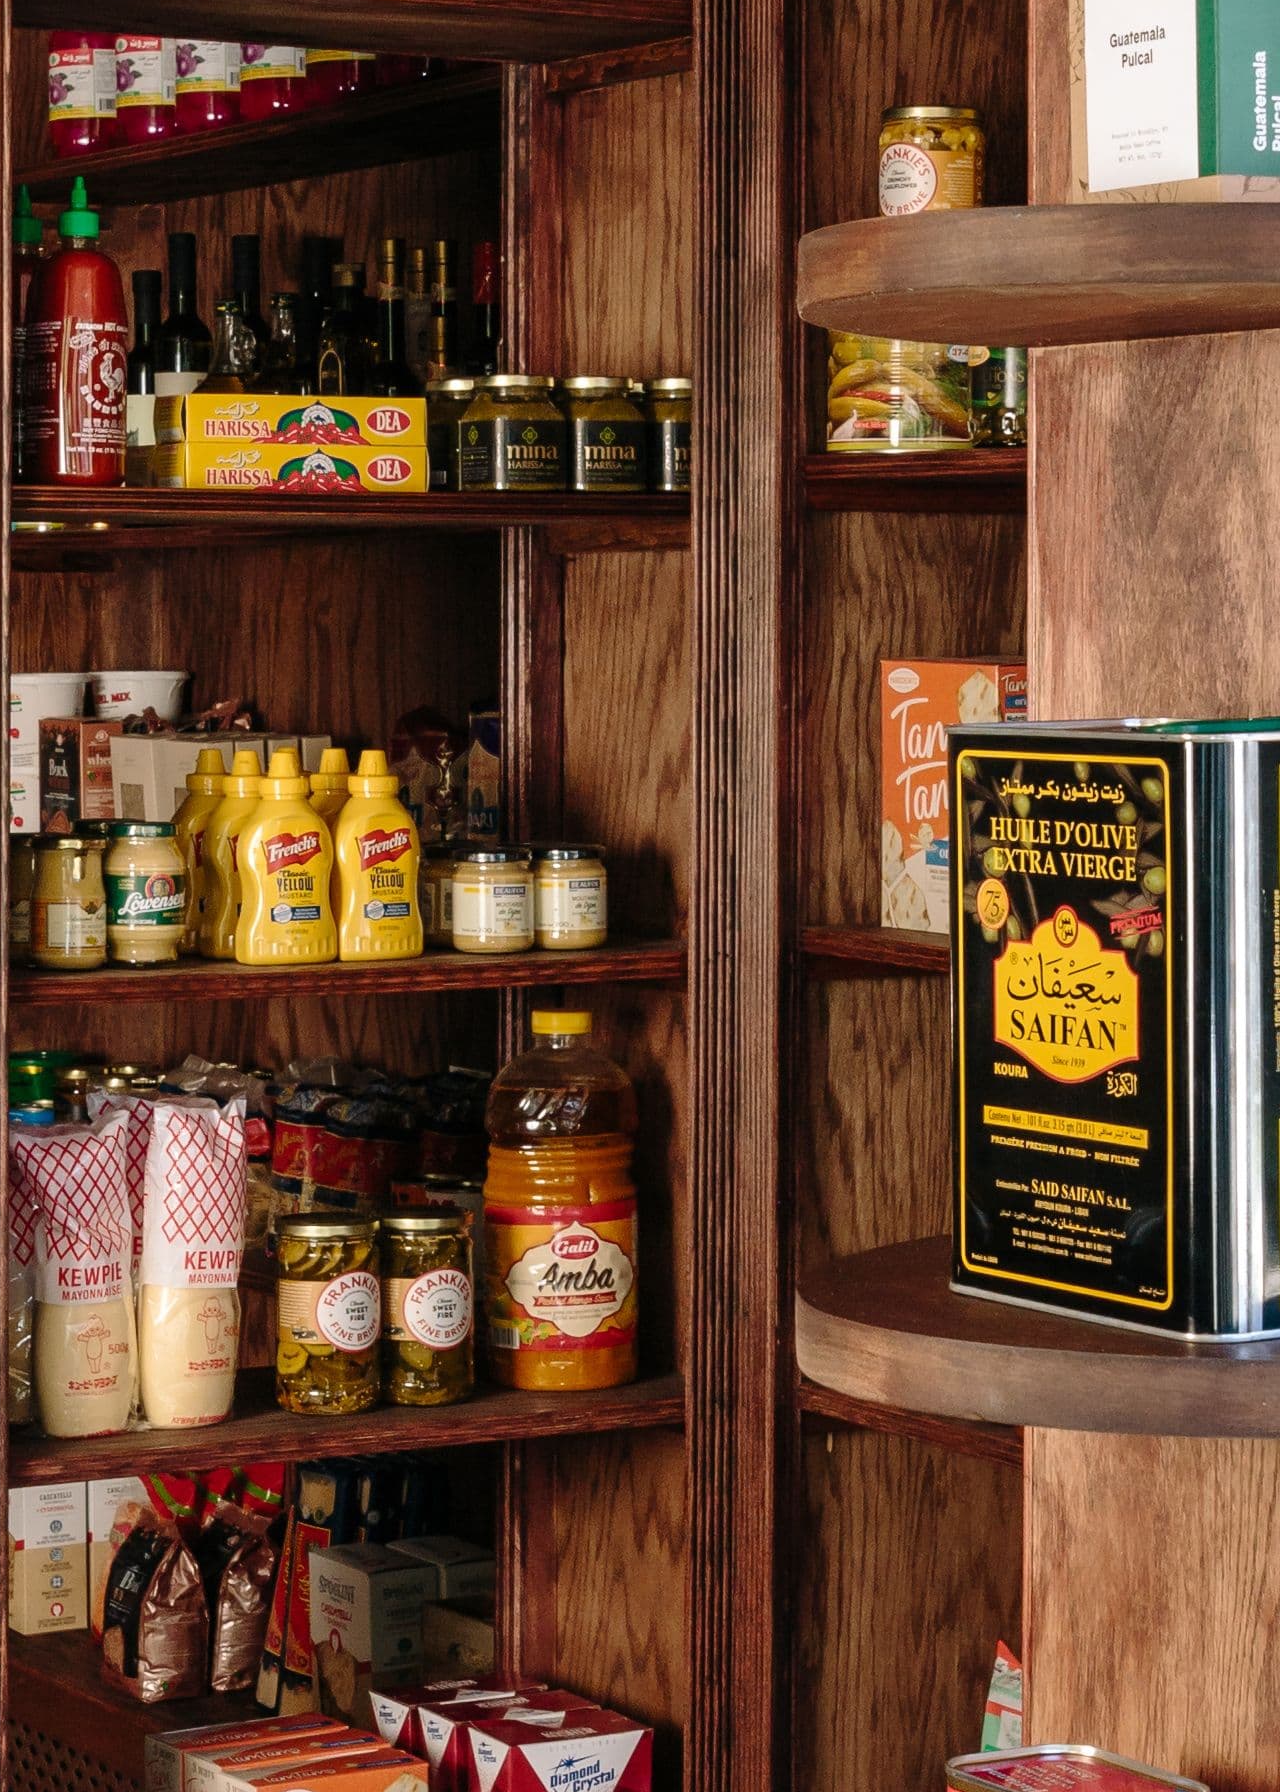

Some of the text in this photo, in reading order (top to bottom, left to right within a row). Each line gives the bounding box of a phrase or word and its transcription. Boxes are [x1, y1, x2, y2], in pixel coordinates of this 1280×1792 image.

[1109, 25, 1166, 49] Guatemala
[1121, 48, 1154, 69] Pulcal
[1252, 50, 1267, 153] Guatemala
[896, 190, 929, 215] BRINE
[205, 420, 272, 438] HARISSA
[376, 411, 401, 431] DEA
[506, 444, 559, 460] mina
[584, 444, 637, 460] mina
[206, 469, 273, 486] HARISSA
[377, 459, 401, 480] DEA
[989, 816, 1137, 851] HUILE D'OLIVE
[268, 836, 317, 863] French's
[362, 833, 408, 859] French's
[993, 846, 1137, 882] EXTRA VIERGE
[277, 877, 314, 892] YELLOW
[370, 873, 404, 890] YELLOW
[985, 889, 1001, 917] 75
[1109, 909, 1163, 935] PREMIUM
[1009, 1009, 1118, 1053] SAIFAN
[993, 1062, 1029, 1079] KOURA
[1031, 1178, 1105, 1206] SAID SAIFAN
[554, 1239, 596, 1256] Galil
[537, 1258, 615, 1293] Amba
[330, 1321, 353, 1342] FINE
[417, 1318, 440, 1338] FINE
[550, 1760, 601, 1788] Diamond
[572, 1767, 616, 1792] Crystal
